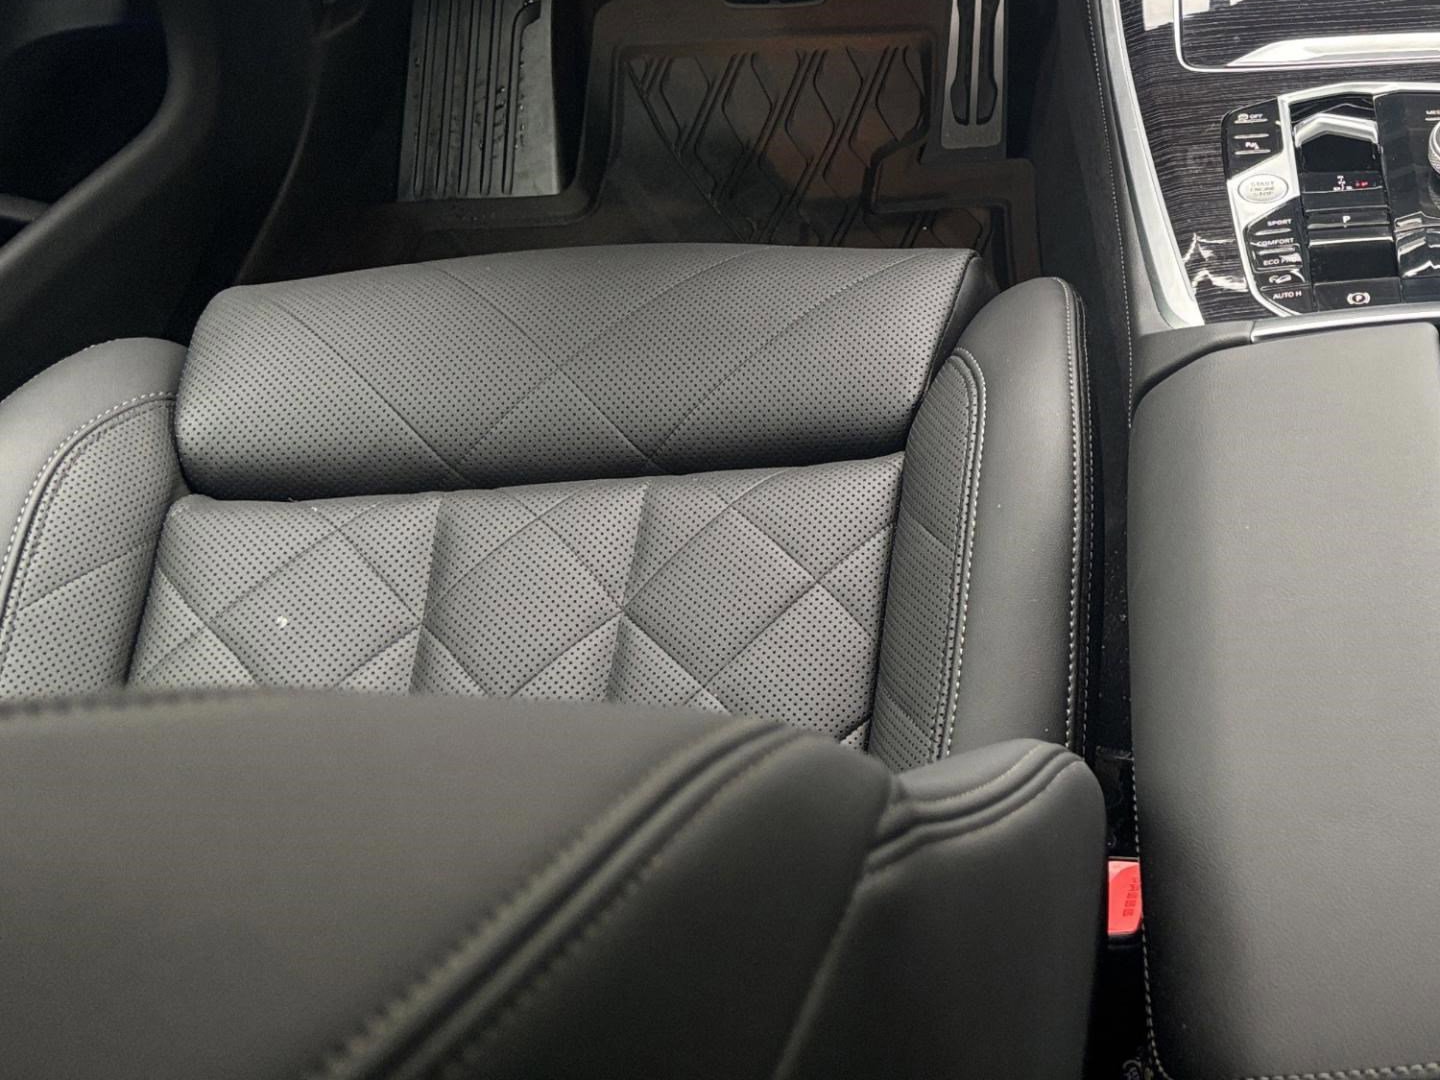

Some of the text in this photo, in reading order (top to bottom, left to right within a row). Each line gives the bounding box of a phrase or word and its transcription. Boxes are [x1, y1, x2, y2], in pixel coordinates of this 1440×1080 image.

[1267, 219, 1292, 227] SPORT
[1257, 237, 1295, 247] COMFORT
[1263, 258, 1279, 266] ECO
[1273, 292, 1295, 300] AUTO
